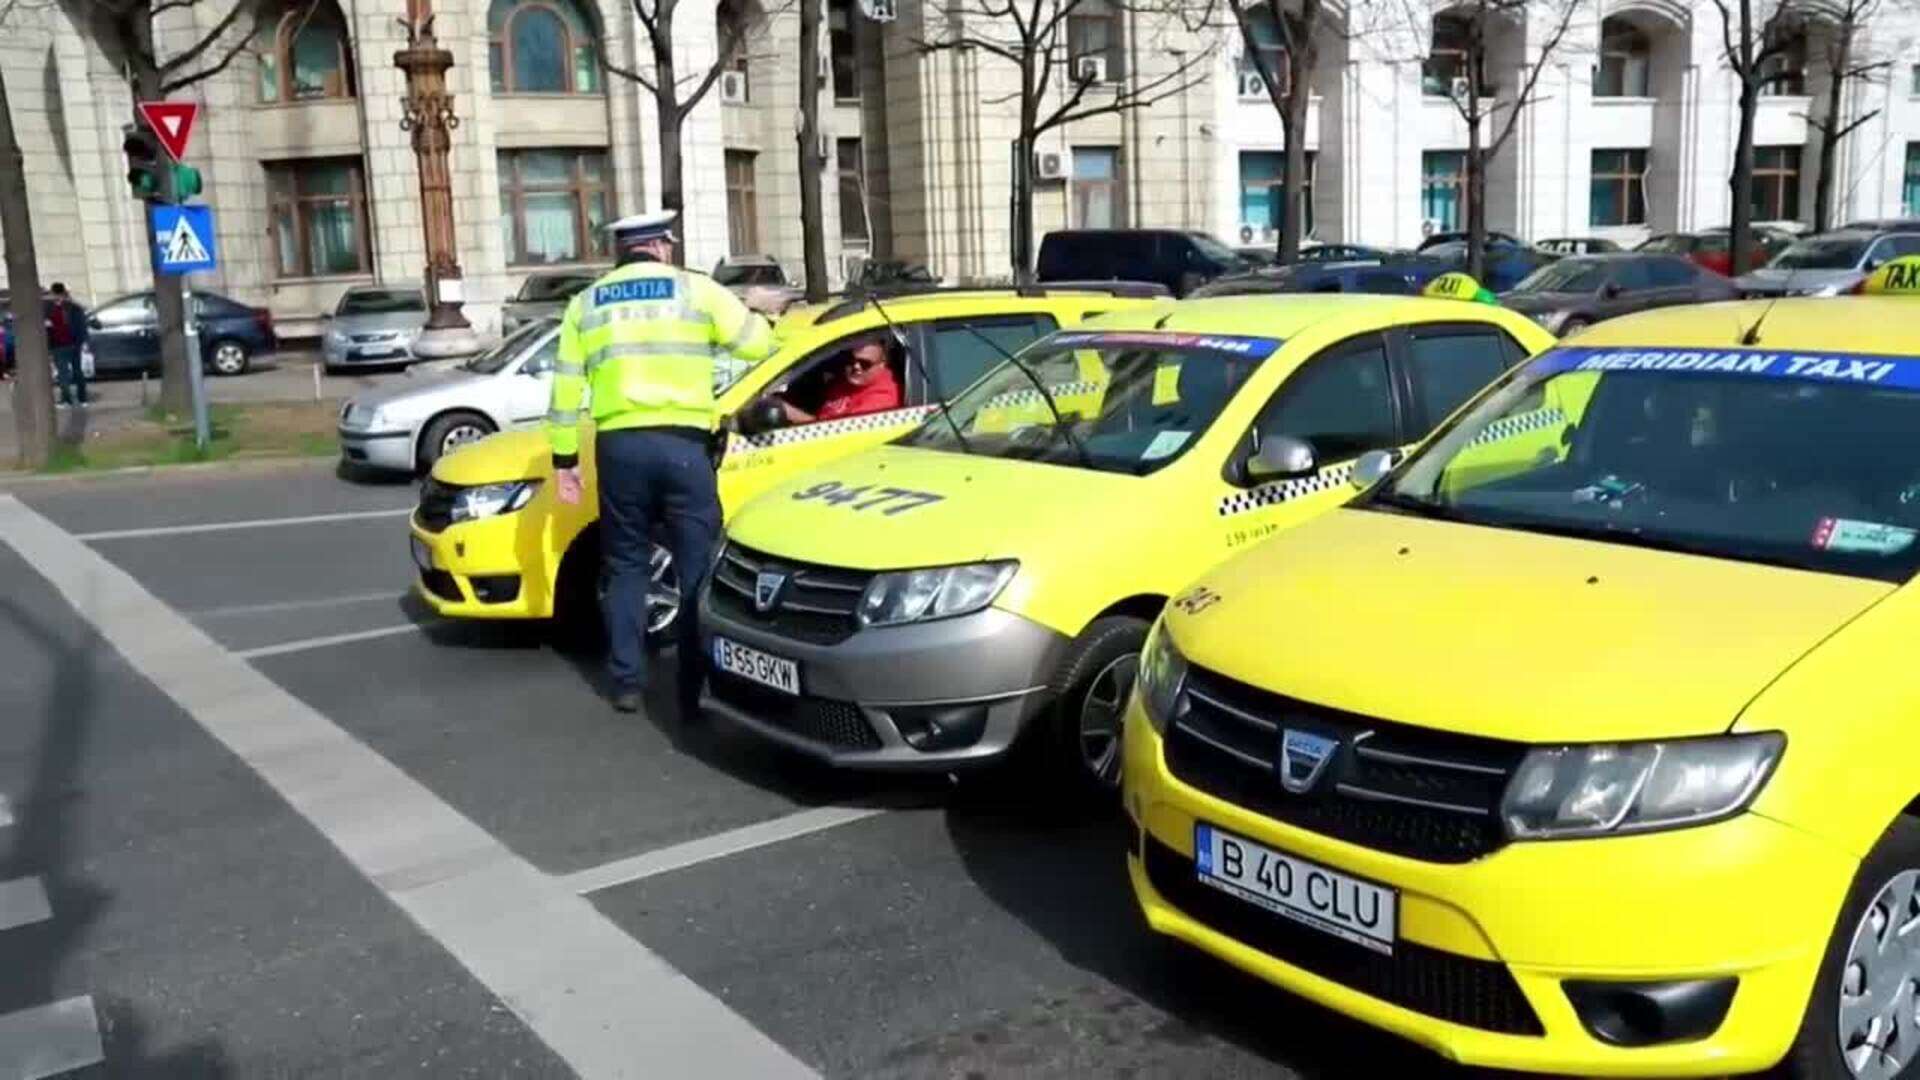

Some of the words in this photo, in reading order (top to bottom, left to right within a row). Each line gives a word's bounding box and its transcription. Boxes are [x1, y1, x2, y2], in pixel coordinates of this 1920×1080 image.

[1577, 352, 1777, 373] MERIDIAN
[1785, 356, 1897, 381] TAXI
[791, 481, 948, 516] 9477
[723, 639, 733, 667] B
[757, 655, 792, 690] GKW
[1223, 840, 1244, 879] B
[1256, 853, 1293, 898] 40
[1307, 871, 1379, 929] CLU
